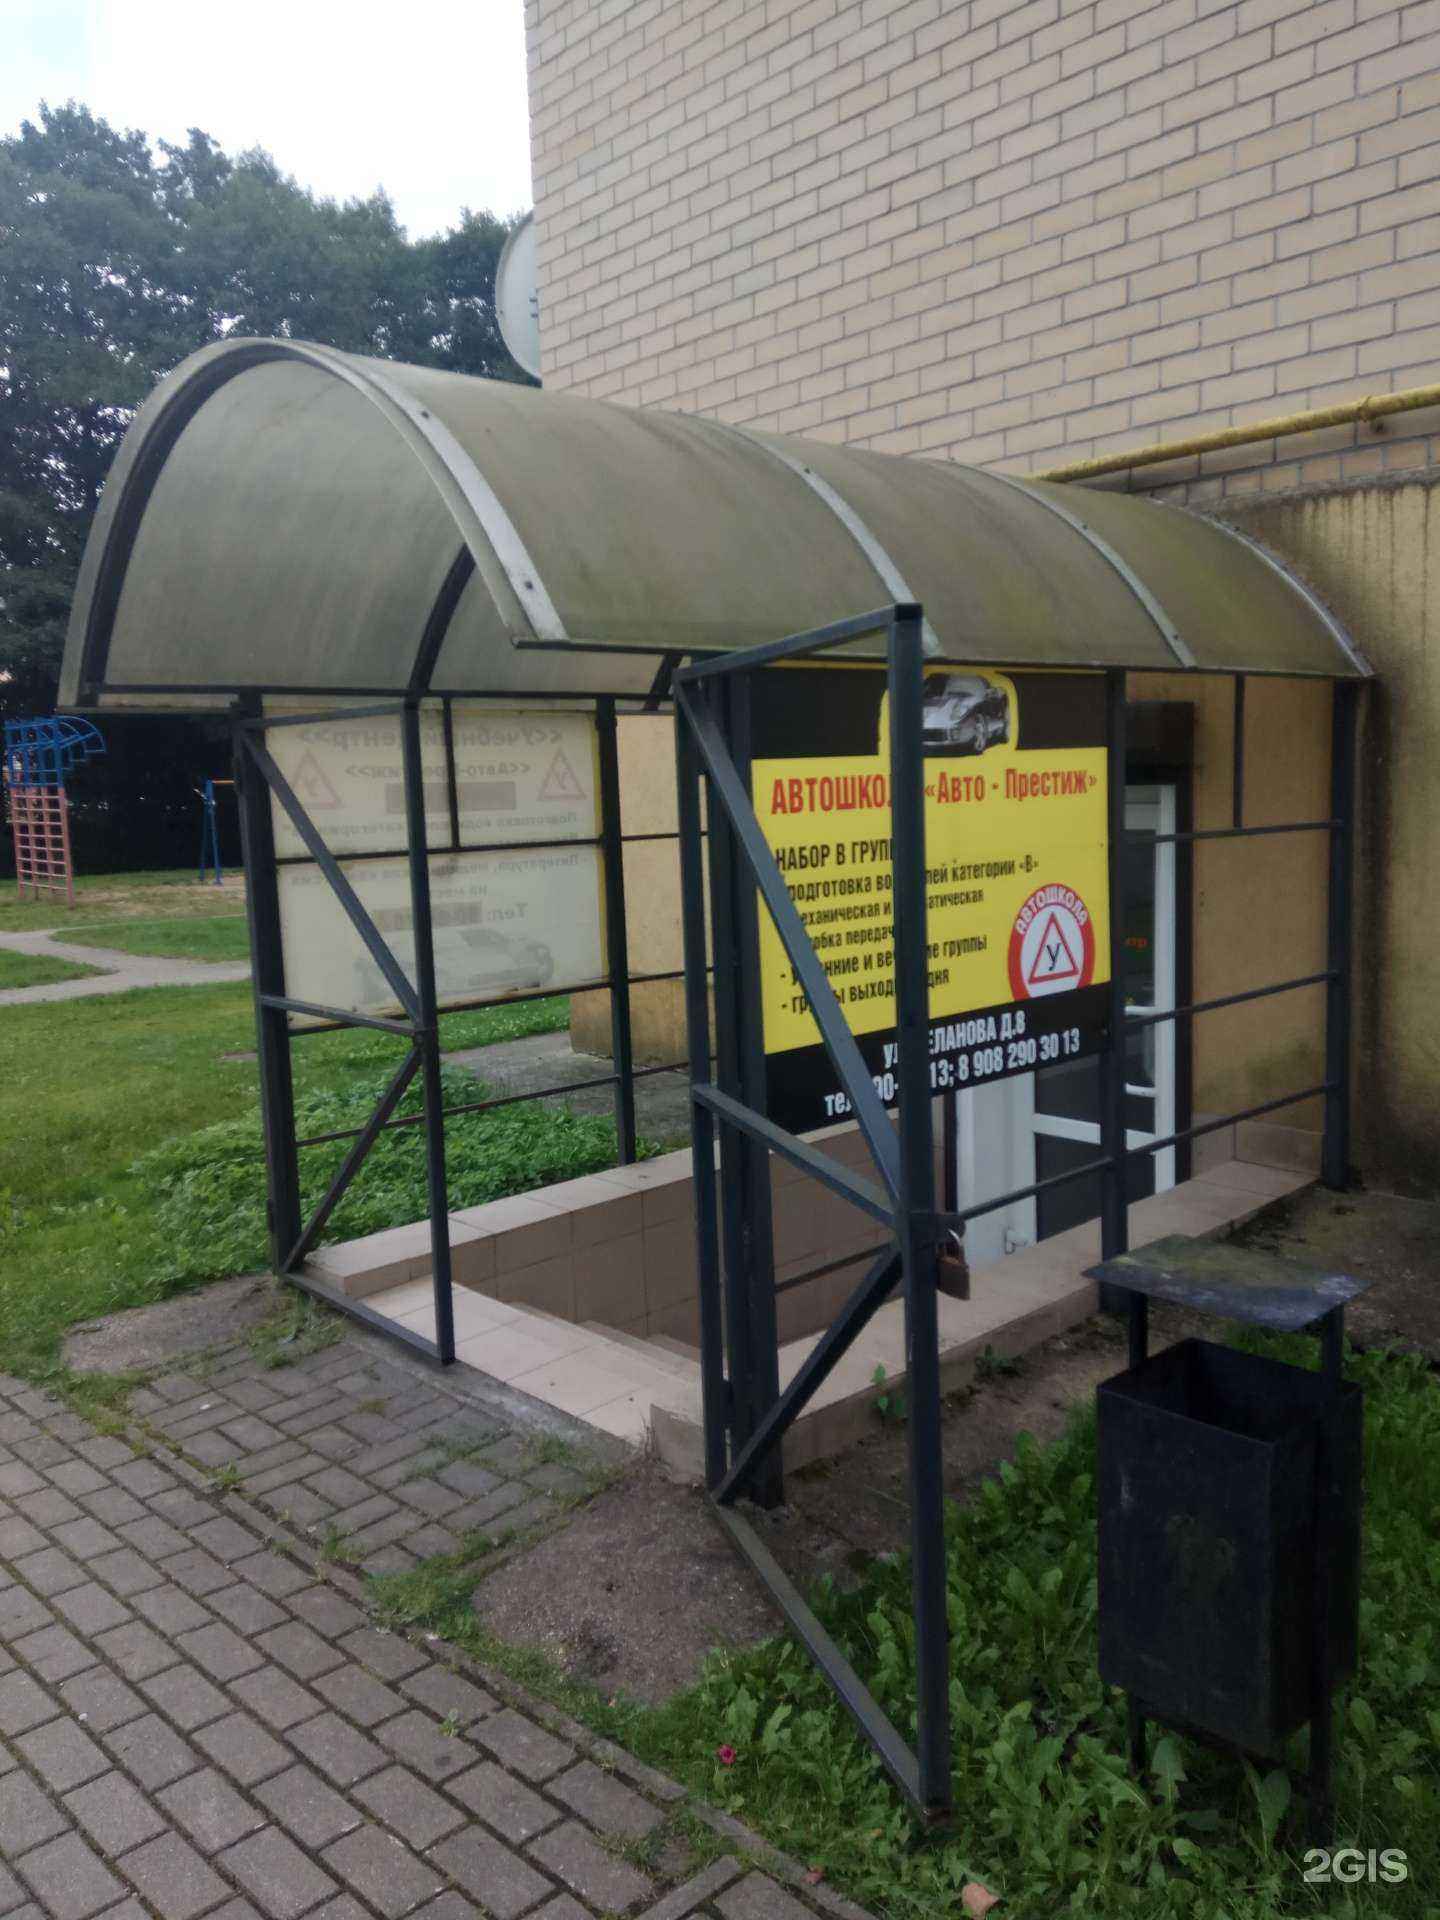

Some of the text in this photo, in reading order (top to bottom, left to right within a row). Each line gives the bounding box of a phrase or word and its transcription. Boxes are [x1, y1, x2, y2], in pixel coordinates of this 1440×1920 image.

[771, 774, 892, 815] АВТОШКО
[922, 772, 986, 803] «Авто
[1005, 768, 1097, 801] Престиж»
[776, 844, 831, 870] НАБОР
[836, 843, 846, 865] В
[952, 860, 1015, 882] категории
[801, 903, 881, 925] еханическая
[1016, 885, 1089, 935] АВТОШКОЛА
[864, 953, 873, 971] и
[943, 935, 988, 958] группы
[1046, 943, 1061, 971] У
[926, 968, 950, 988] дня
[999, 1010, 1026, 1041] Д.8
[957, 1054, 970, 1081] 8
[973, 1046, 1004, 1078] 908
[1007, 1037, 1037, 1069] 290
[1040, 1032, 1060, 1060] 30
[1063, 1027, 1081, 1055] 13
